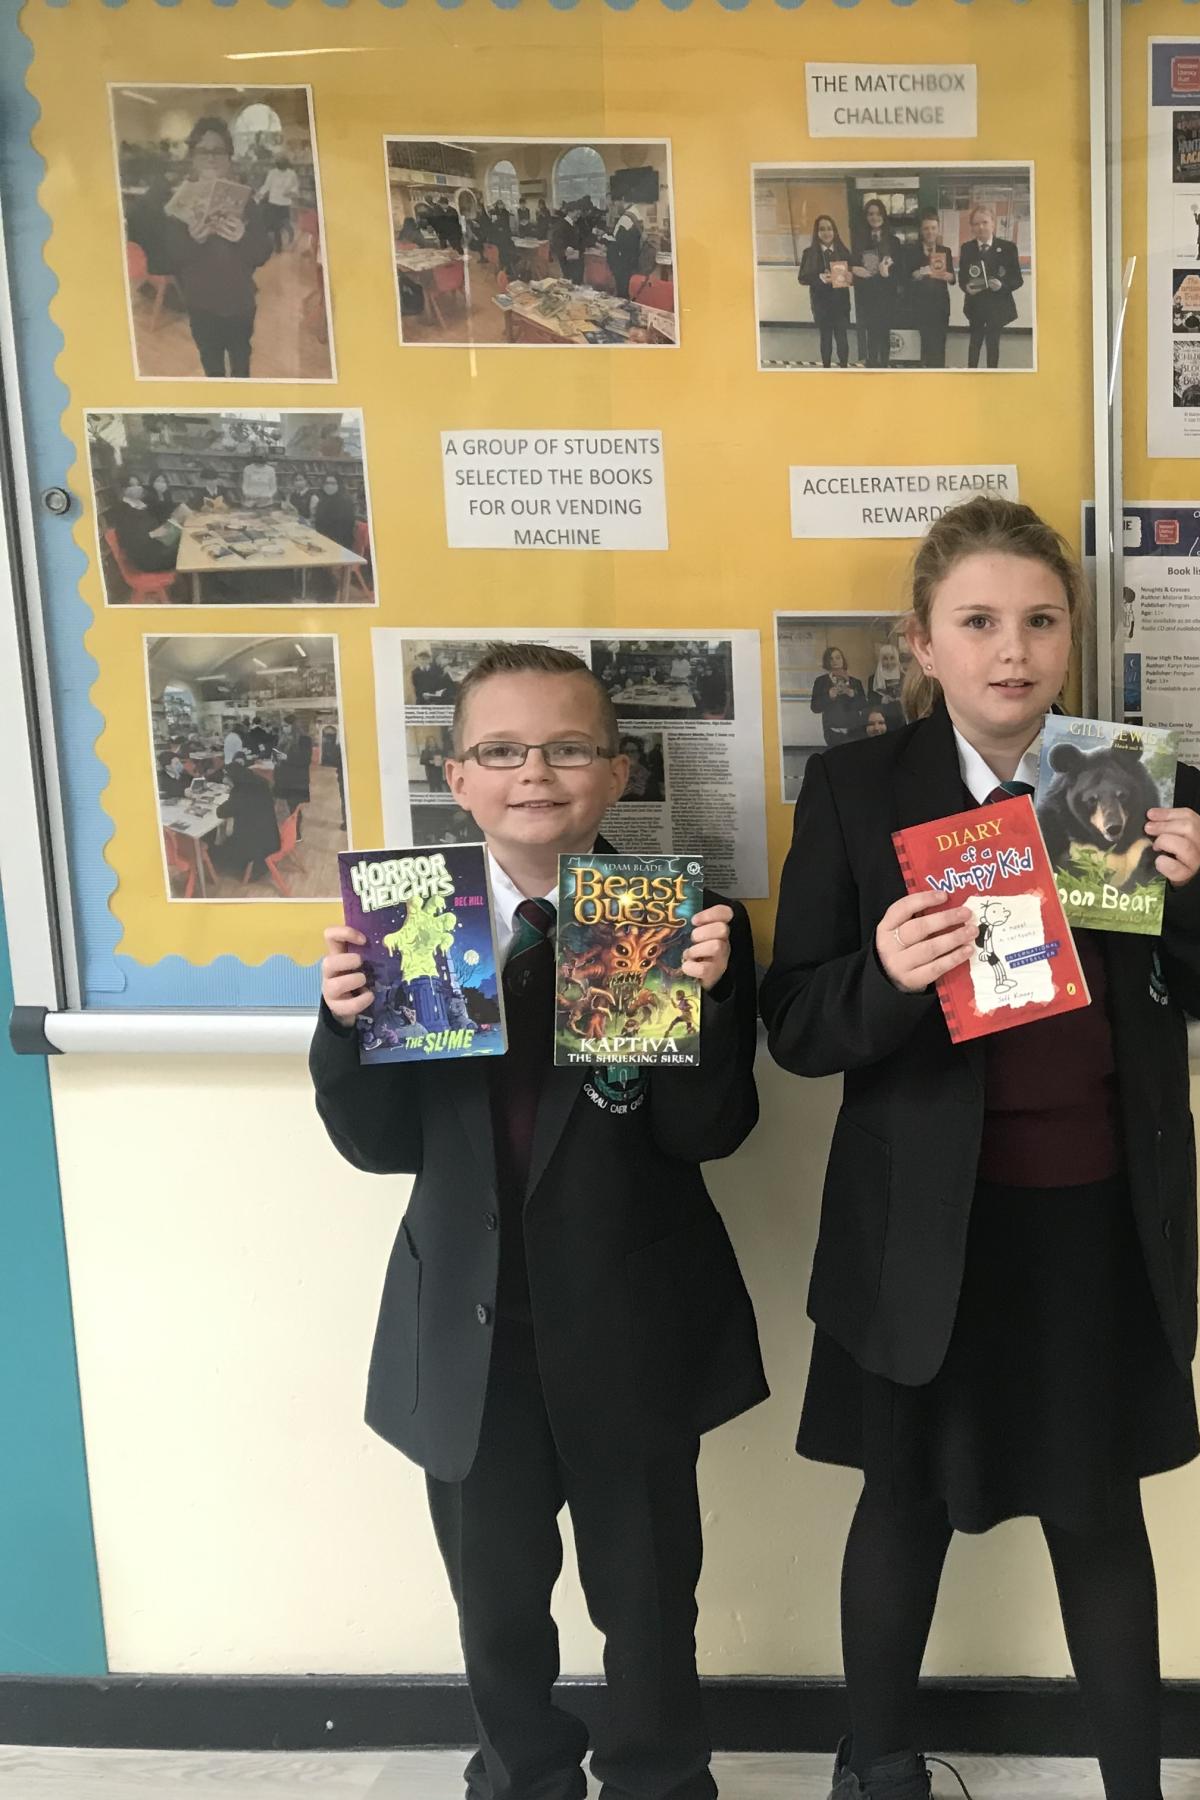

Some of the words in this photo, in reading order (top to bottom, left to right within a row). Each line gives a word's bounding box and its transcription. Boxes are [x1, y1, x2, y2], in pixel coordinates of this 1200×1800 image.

[812, 75, 848, 92] THE
[855, 74, 965, 92] MATCHBOX
[834, 106, 944, 125] CHALLENGE
[445, 440, 457, 455] A
[463, 439, 528, 455] GROUP
[534, 439, 559, 454] OF
[564, 438, 660, 454] STUDENTS
[455, 469, 542, 485] SELECTED
[548, 469, 583, 485] THE
[590, 469, 653, 485] BOOKS
[803, 476, 930, 495] ACCELERATED
[936, 474, 1009, 491] READER
[469, 500, 505, 515] FOR
[511, 500, 551, 515] OUR
[556, 499, 642, 515] VENDING
[514, 529, 601, 545] MACHINE
[1167, 567, 1191, 576] Book
[1069, 722, 1105, 739] GILL
[1112, 728, 1158, 745] LEWIS
[936, 818, 1003, 852] DIARY
[961, 846, 977, 863] of
[982, 849, 992, 860] a
[350, 853, 450, 896] HORROR
[602, 862, 631, 872] ADAM
[633, 863, 663, 872] BLADE
[926, 858, 995, 894] Wimpy
[998, 847, 1032, 878] Kid
[568, 867, 688, 901] Beast
[360, 875, 455, 913] HEIGHTS
[454, 897, 467, 907] BEC
[469, 896, 484, 906] HILL
[1101, 883, 1158, 915] Bear
[573, 899, 687, 928] Quest
[405, 1036, 424, 1049] THE
[424, 1029, 475, 1055] SLIME
[581, 1037, 678, 1053] KAPTIVA
[568, 1053, 592, 1063] THE
[596, 1053, 657, 1064] SHRIEKING
[661, 1053, 694, 1064] SIREN
[610, 1104, 628, 1115] CAER
